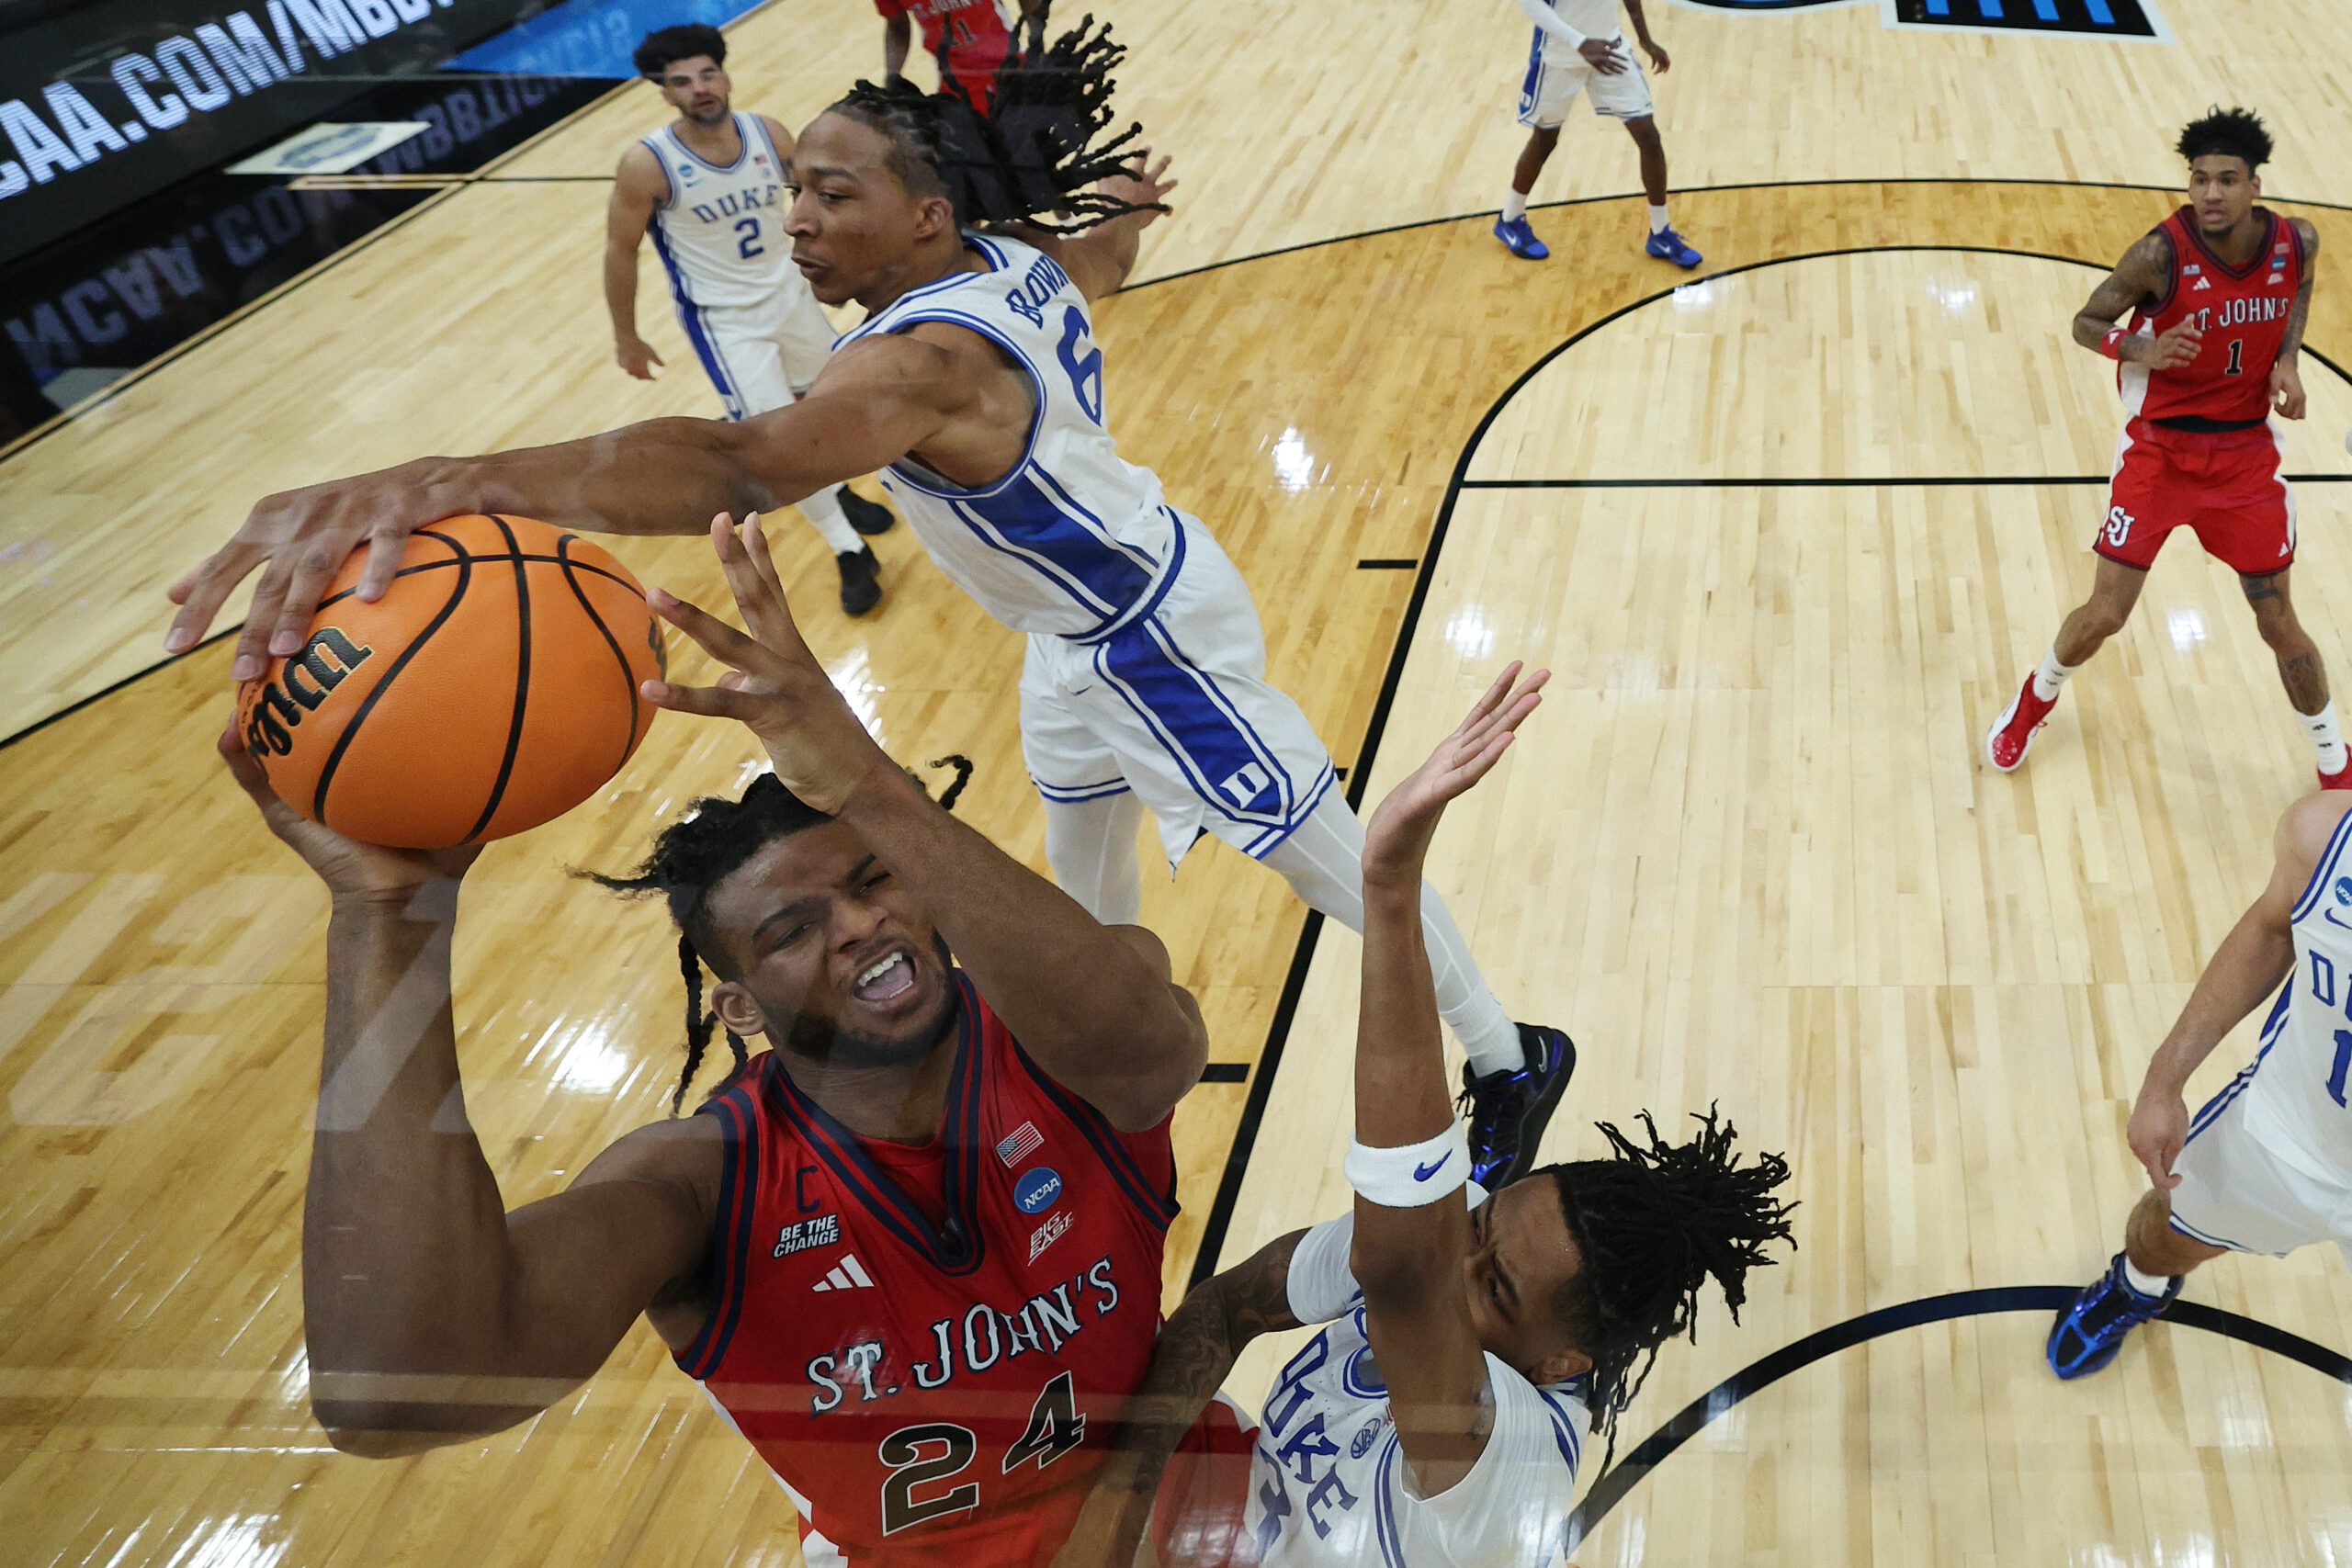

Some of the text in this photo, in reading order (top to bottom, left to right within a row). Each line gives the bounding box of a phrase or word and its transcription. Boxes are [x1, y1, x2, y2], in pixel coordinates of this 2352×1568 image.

[734, 217, 764, 259] 2
[1057, 305, 1102, 427] 6
[2224, 338, 2243, 376] 1
[796, 1165, 820, 1213] C
[1024, 1177, 1060, 1210] NCAA
[774, 1228, 839, 1258] CHANGE
[780, 1214, 837, 1243] BE THE
[1029, 1212, 1072, 1259] EAST
[1031, 1211, 1061, 1247] BIG
[806, 1255, 1120, 1418] ST. JOHN'S
[877, 1369, 1087, 1538] 24
[1261, 1325, 1360, 1541] DUKE
